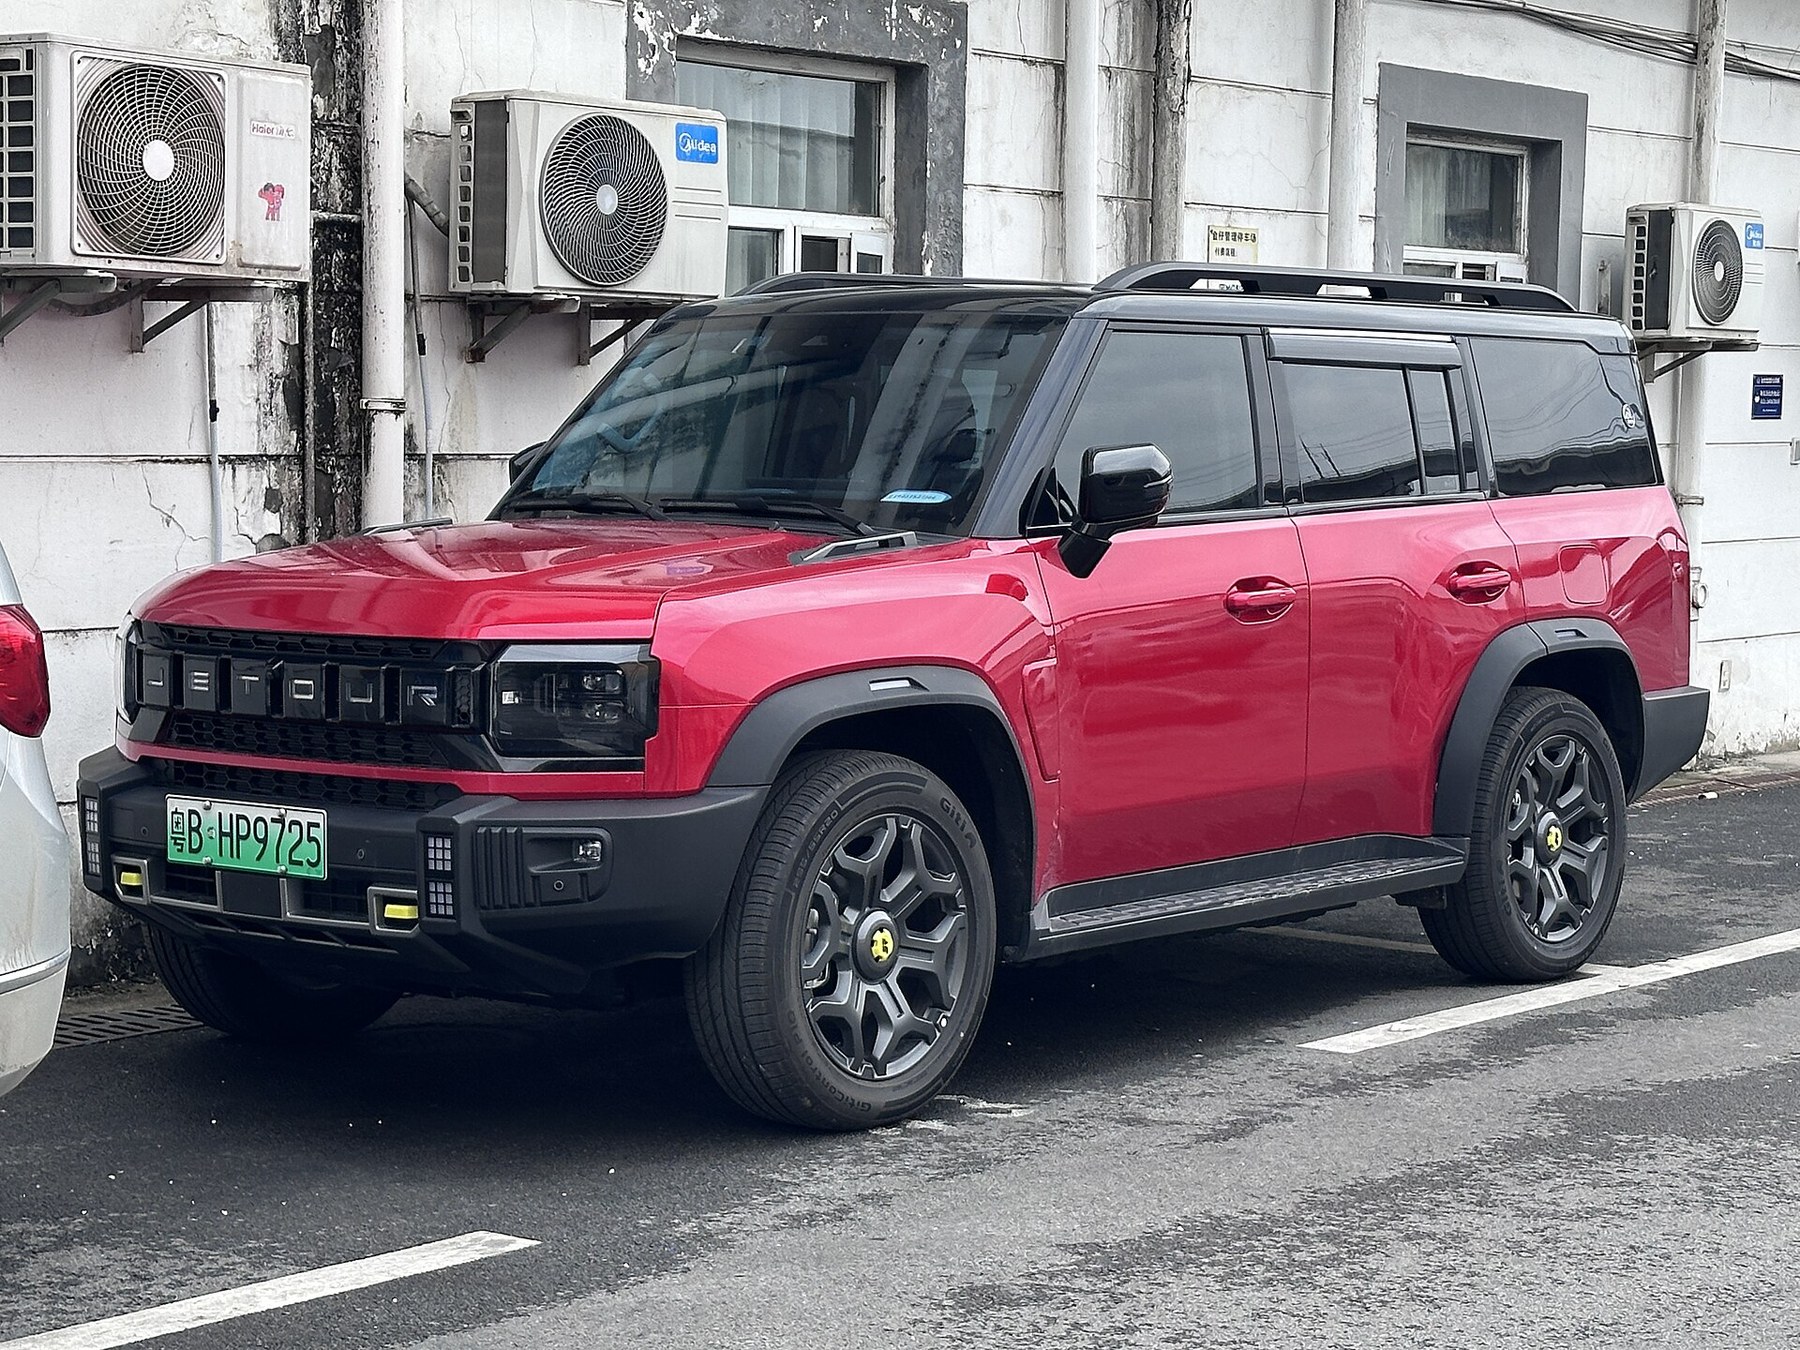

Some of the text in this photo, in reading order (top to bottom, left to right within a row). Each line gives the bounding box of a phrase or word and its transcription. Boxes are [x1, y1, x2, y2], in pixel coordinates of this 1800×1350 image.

[251, 123, 274, 135] Haier
[679, 132, 717, 153] Midea
[147, 667, 438, 707] JETOUR
